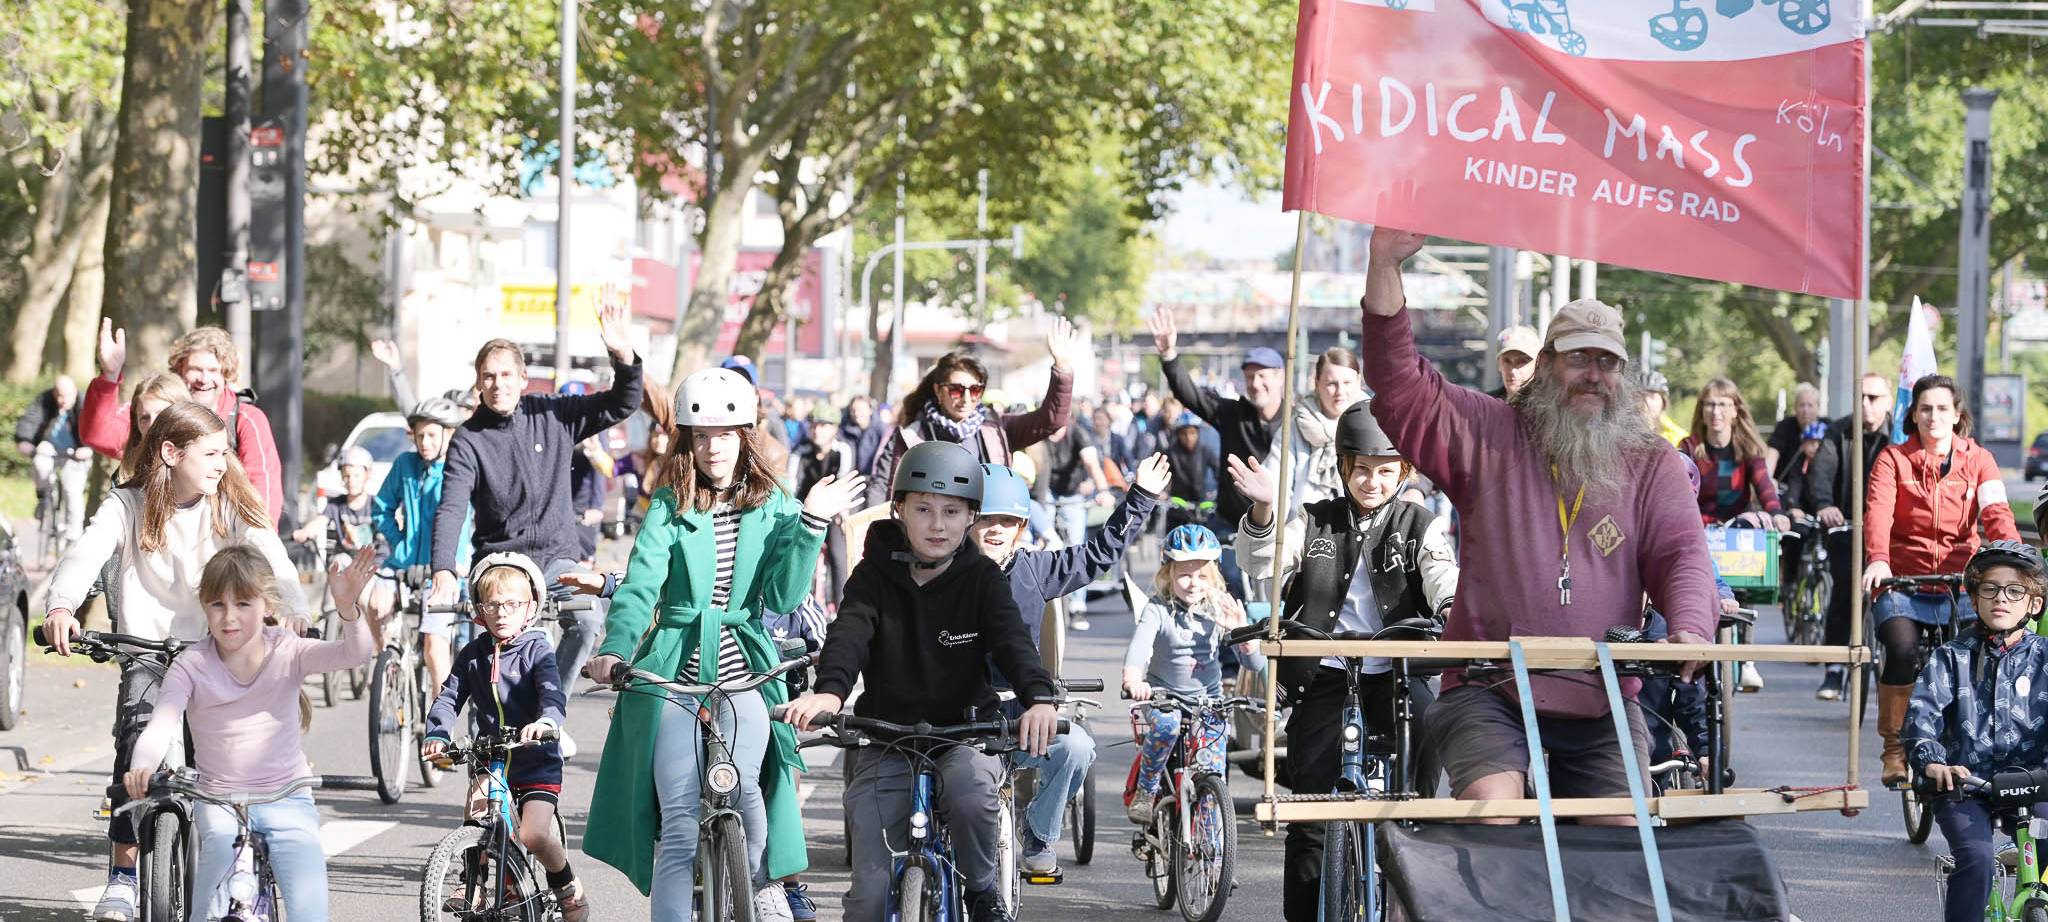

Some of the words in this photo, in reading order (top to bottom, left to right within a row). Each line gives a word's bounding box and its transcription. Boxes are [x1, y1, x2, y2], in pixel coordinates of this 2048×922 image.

[1301, 76, 1567, 154] KIDICAL
[1602, 108, 1757, 188] MASS
[1775, 98, 1842, 152] Köln
[1464, 156, 1578, 198] KINDER
[1591, 178, 1675, 213] AUFS
[1679, 191, 1741, 223] RAD
